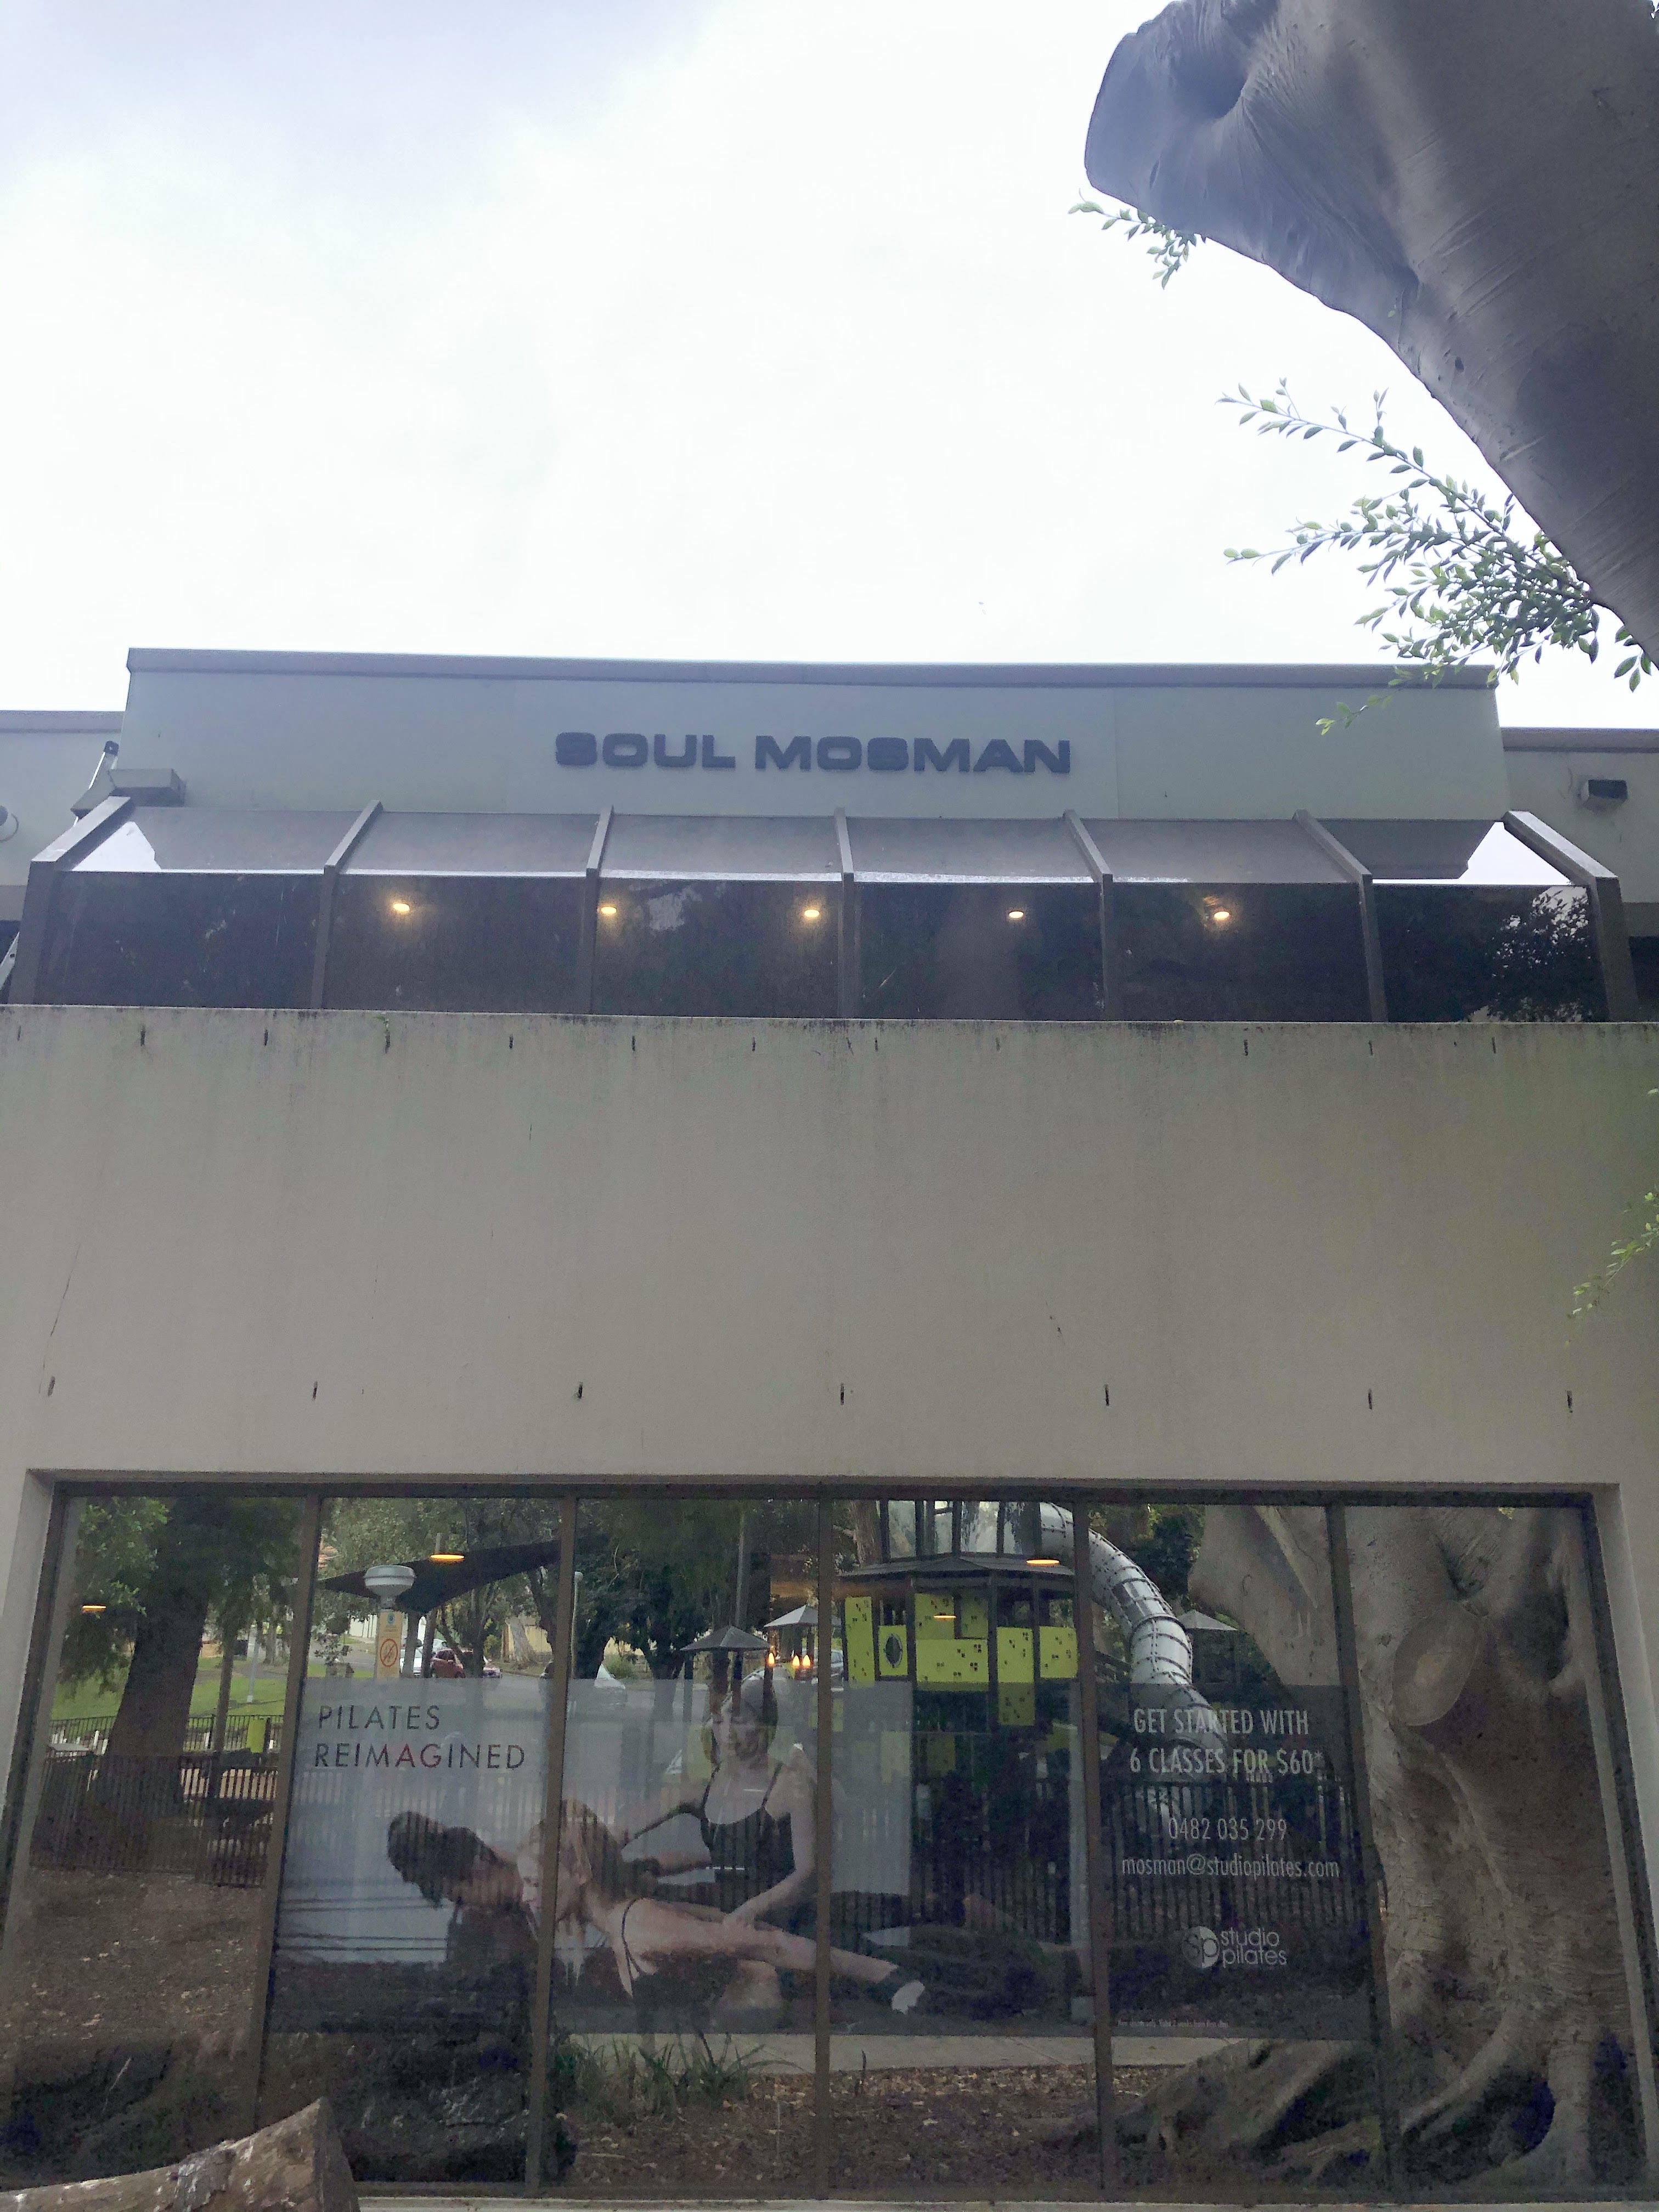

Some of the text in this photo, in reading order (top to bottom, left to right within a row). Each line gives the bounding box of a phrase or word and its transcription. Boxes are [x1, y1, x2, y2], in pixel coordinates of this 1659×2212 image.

[555, 731, 1071, 774] SOUL MOSMAN
[319, 1705, 439, 1730] PILATES
[1133, 1708, 1309, 1735] GET STARTED WITH
[314, 1742, 525, 1769] REIMAGINED
[1130, 1747, 1141, 1773] 6
[1149, 1747, 1227, 1774] CLASSES
[1233, 1748, 1268, 1774] FOR
[1168, 1817, 1287, 1841] 0482 035 299
[1121, 1853, 1340, 1881] mosman@studiopilates.com
[1221, 1927, 1280, 1946] studio
[1222, 1945, 1287, 1968] pilates
